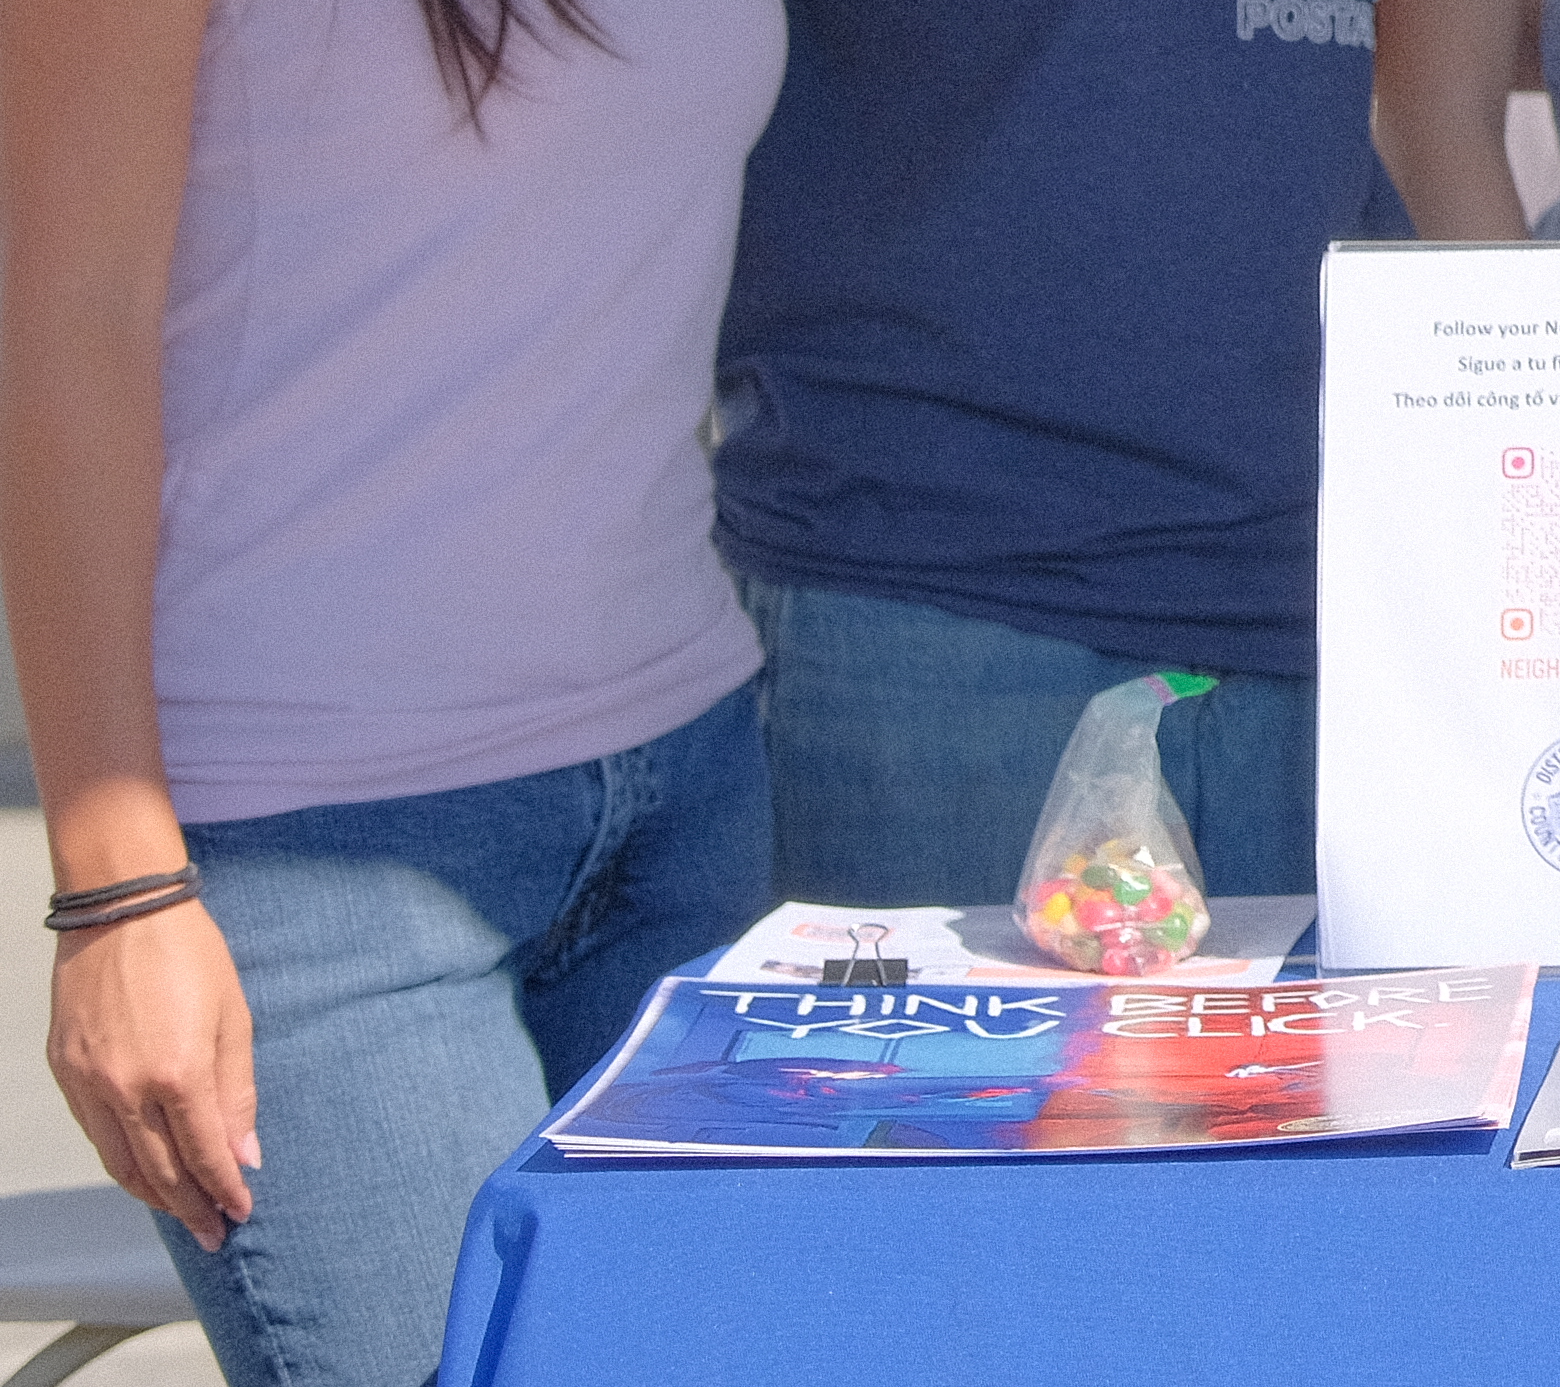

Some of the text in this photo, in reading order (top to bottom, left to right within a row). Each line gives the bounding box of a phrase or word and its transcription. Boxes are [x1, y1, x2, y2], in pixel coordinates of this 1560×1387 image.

[1433, 320, 1493, 337] Follow
[1498, 323, 1538, 339] your
[1458, 356, 1506, 375] Sigue
[1512, 359, 1523, 371] a
[1528, 357, 1547, 371] tu
[1393, 392, 1438, 409] Theo
[699, 977, 1494, 1018] THINK BEFORE
[742, 1010, 1450, 1039] YOU CLICK.
